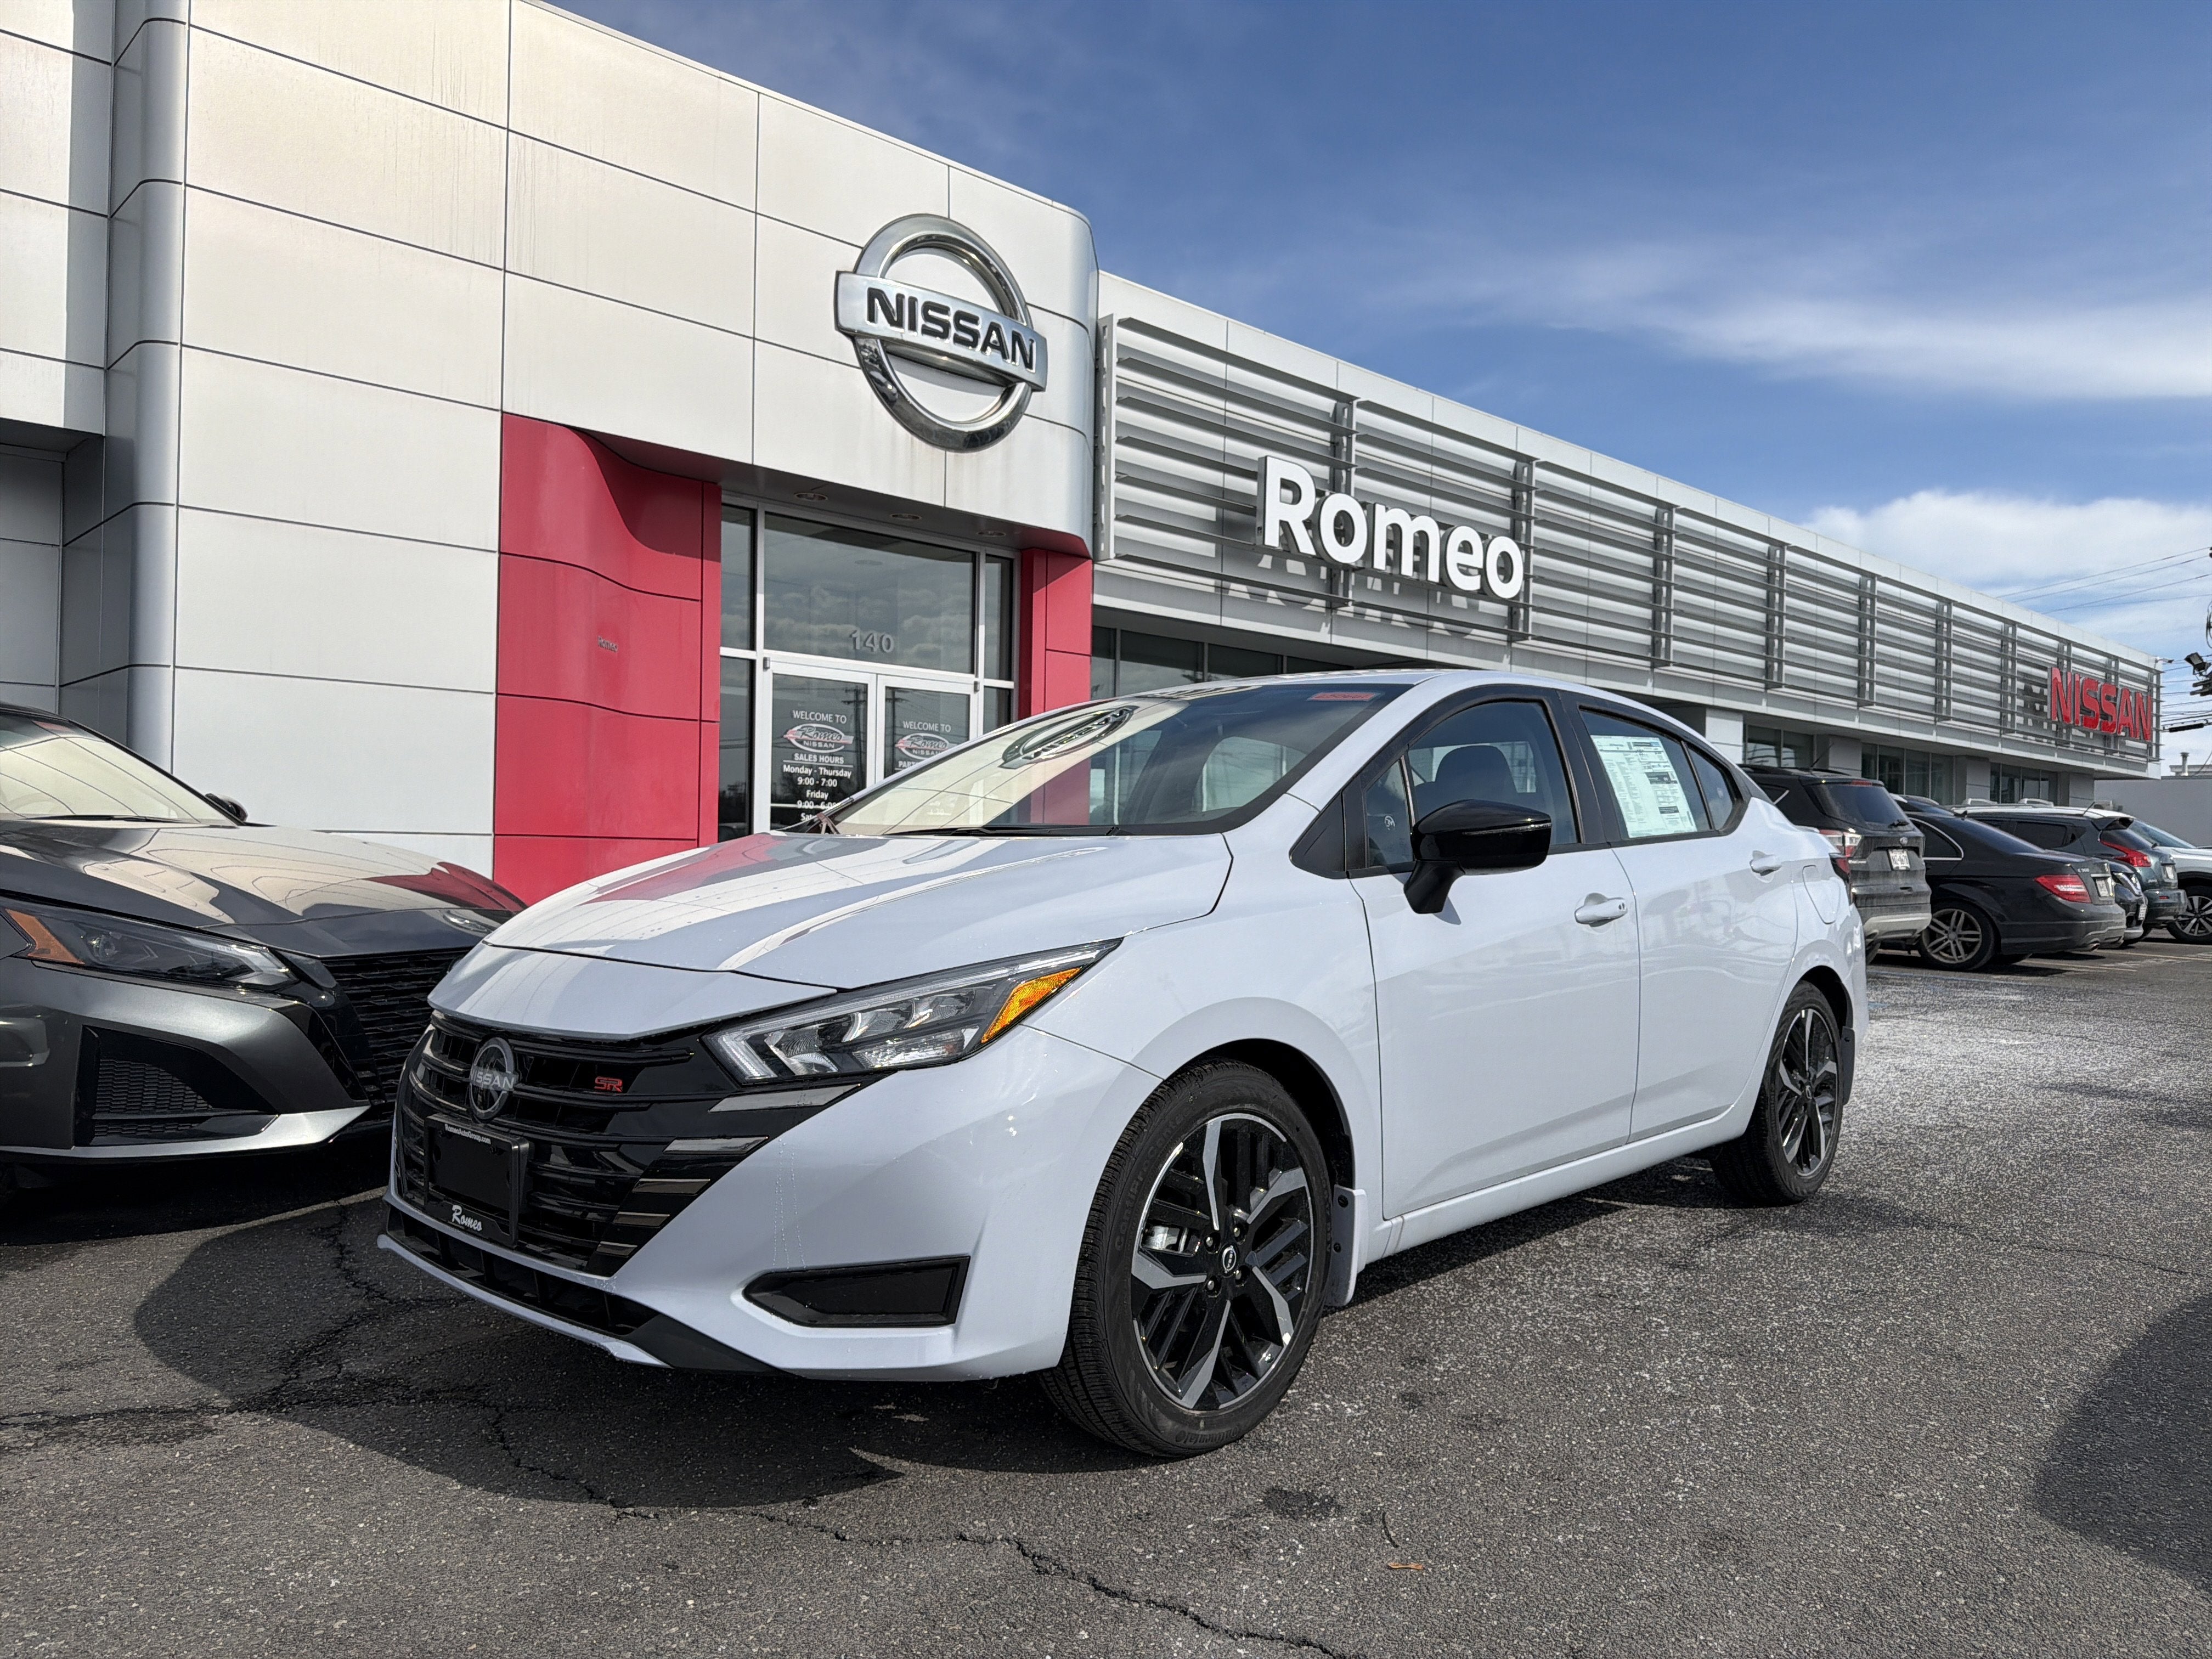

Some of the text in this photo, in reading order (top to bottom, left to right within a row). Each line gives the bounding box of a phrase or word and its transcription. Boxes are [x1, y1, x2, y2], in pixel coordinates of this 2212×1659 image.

[866, 287, 1036, 373] NISSAN
[1261, 455, 1525, 600] Romeo
[851, 630, 894, 653] 140
[2049, 667, 2152, 741] NISSAN
[793, 710, 847, 724] WELCOME TO
[799, 725, 843, 741] Romeo
[903, 720, 951, 732] WELCOME TO
[803, 741, 834, 749] NISSAN
[794, 753, 844, 764] SALES HOURS
[783, 764, 812, 775] Monday
[819, 766, 851, 778] Thursday
[797, 776, 815, 786] 9:00
[821, 778, 837, 787] 7:00
[806, 789, 829, 800] Friday
[797, 800, 814, 809] 9:00
[470, 1069, 515, 1089] NISSAN
[594, 1076, 623, 1092] SR
[444, 1124, 491, 1144] RomeoAutoGroup.com
